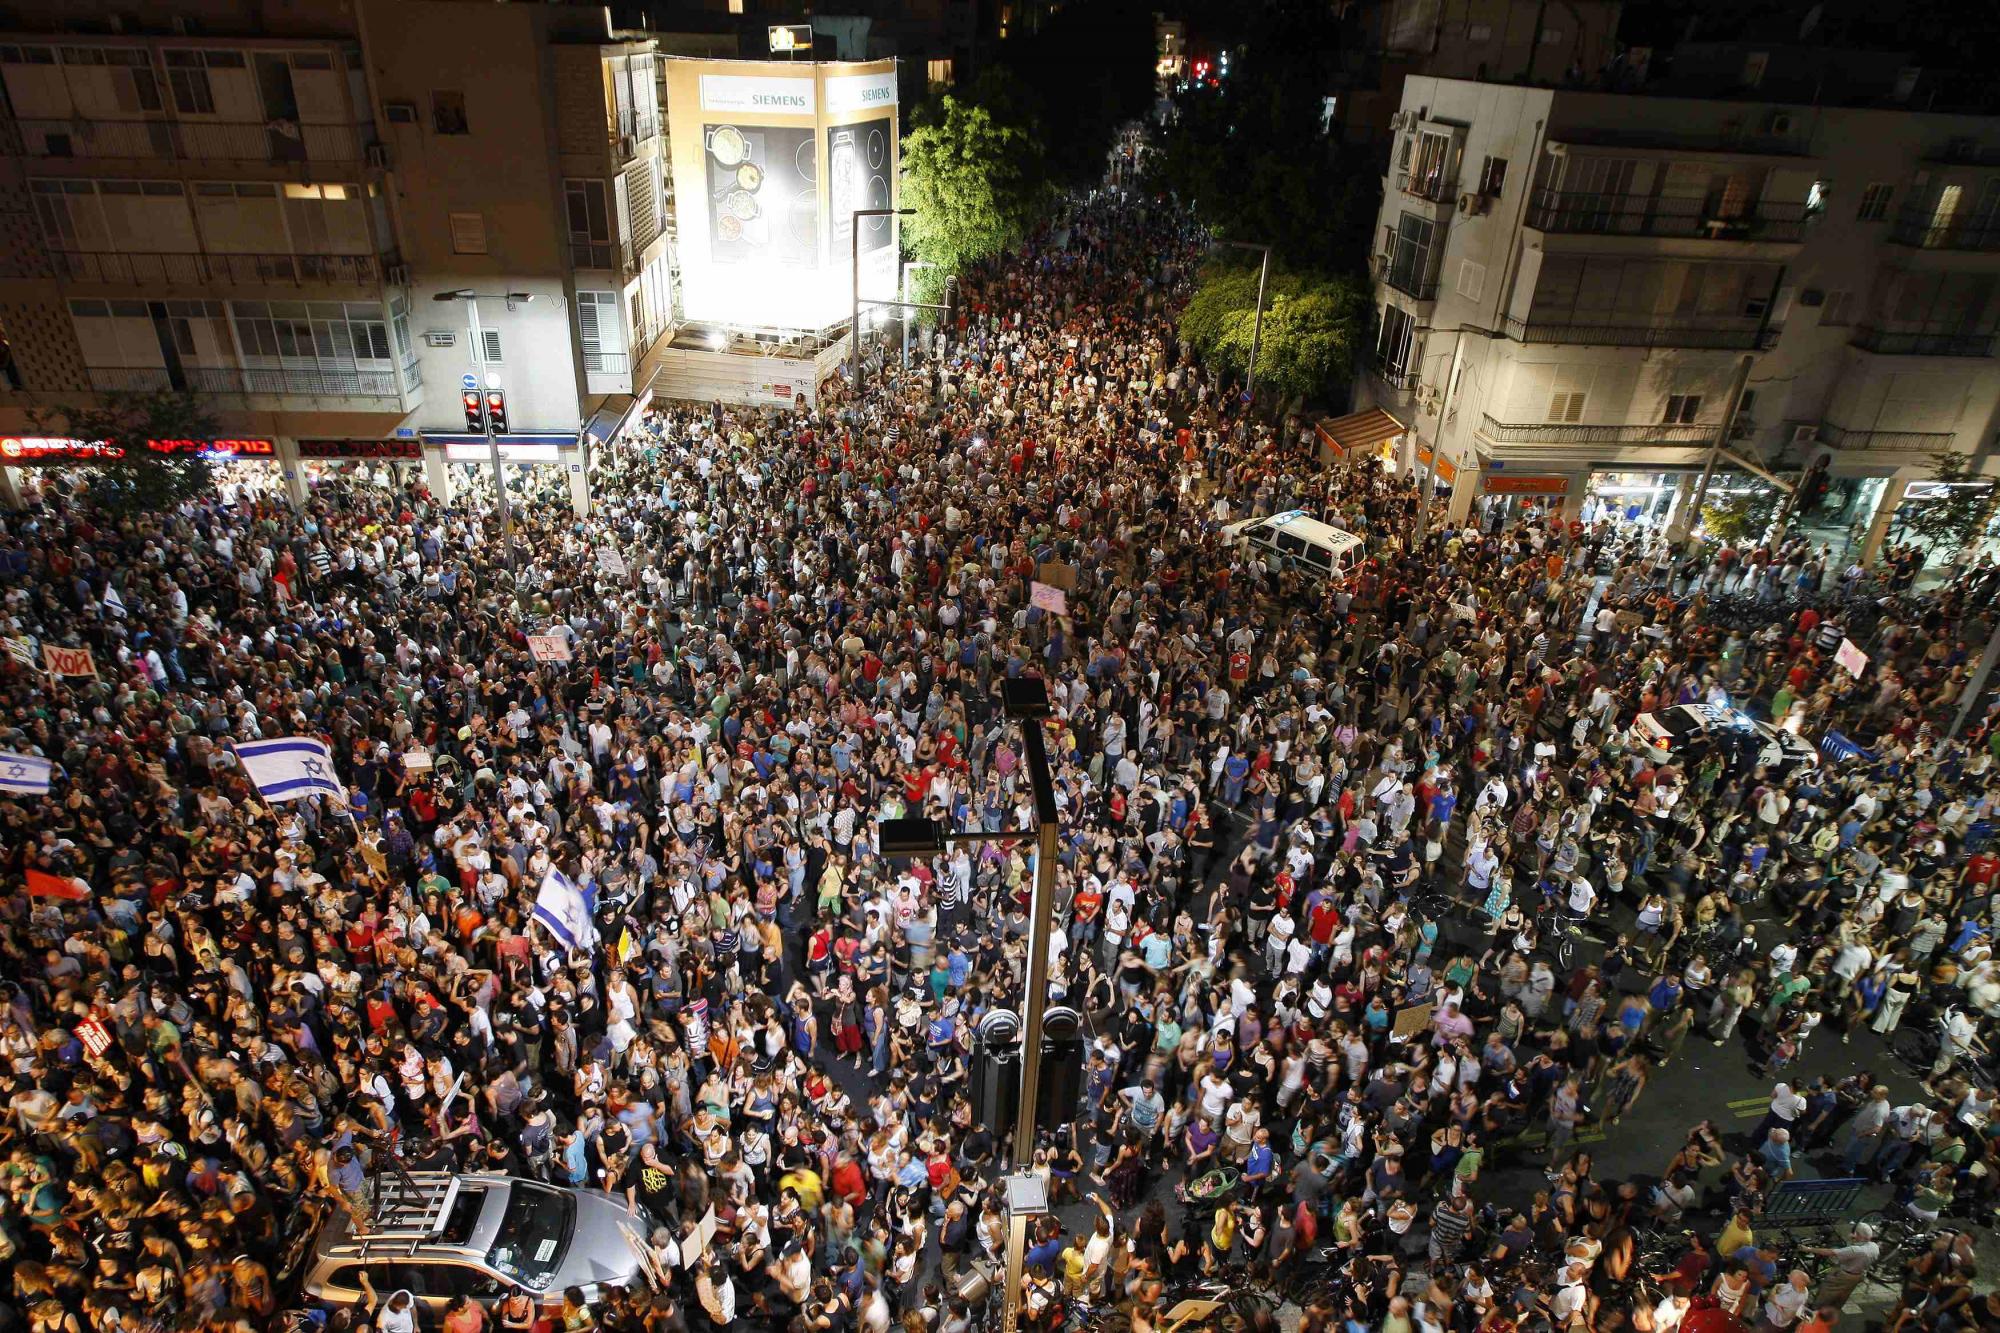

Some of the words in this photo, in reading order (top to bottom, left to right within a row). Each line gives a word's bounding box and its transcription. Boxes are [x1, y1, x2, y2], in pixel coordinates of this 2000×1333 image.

[752, 94, 806, 106] SIEMENS
[862, 87, 890, 102] SIEMENS
[213, 440, 273, 455] בורקס
